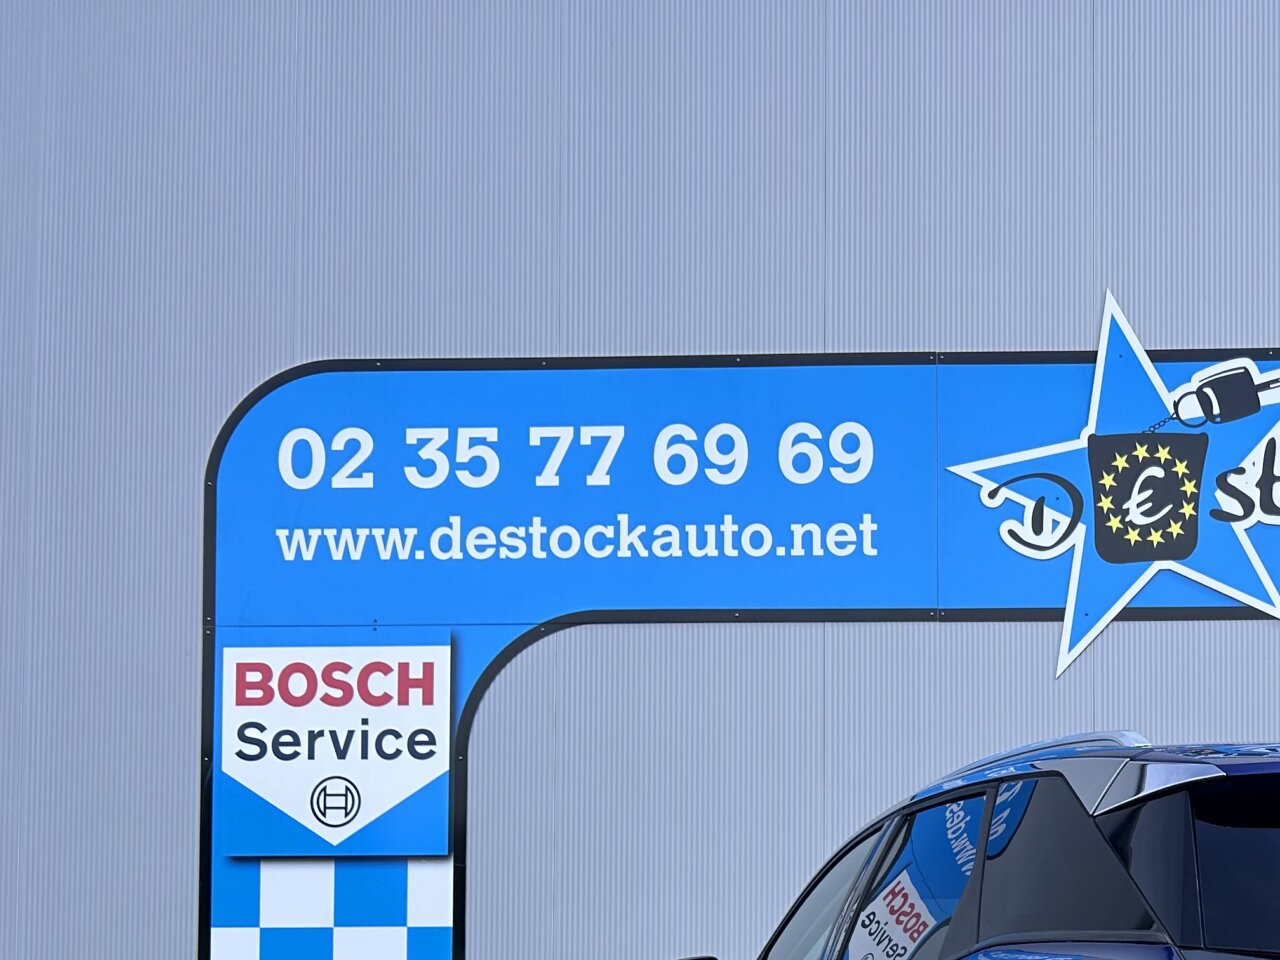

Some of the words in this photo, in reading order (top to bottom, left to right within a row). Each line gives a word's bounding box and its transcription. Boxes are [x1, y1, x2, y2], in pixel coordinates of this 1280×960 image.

[277, 427, 374, 490] 02
[403, 427, 500, 489] 35
[529, 425, 625, 487] 77
[653, 423, 749, 486] 69
[778, 421, 874, 485] 69
[275, 513, 878, 561] www.destockauto.net
[235, 661, 435, 707] BOSCH
[234, 717, 437, 762] Service
